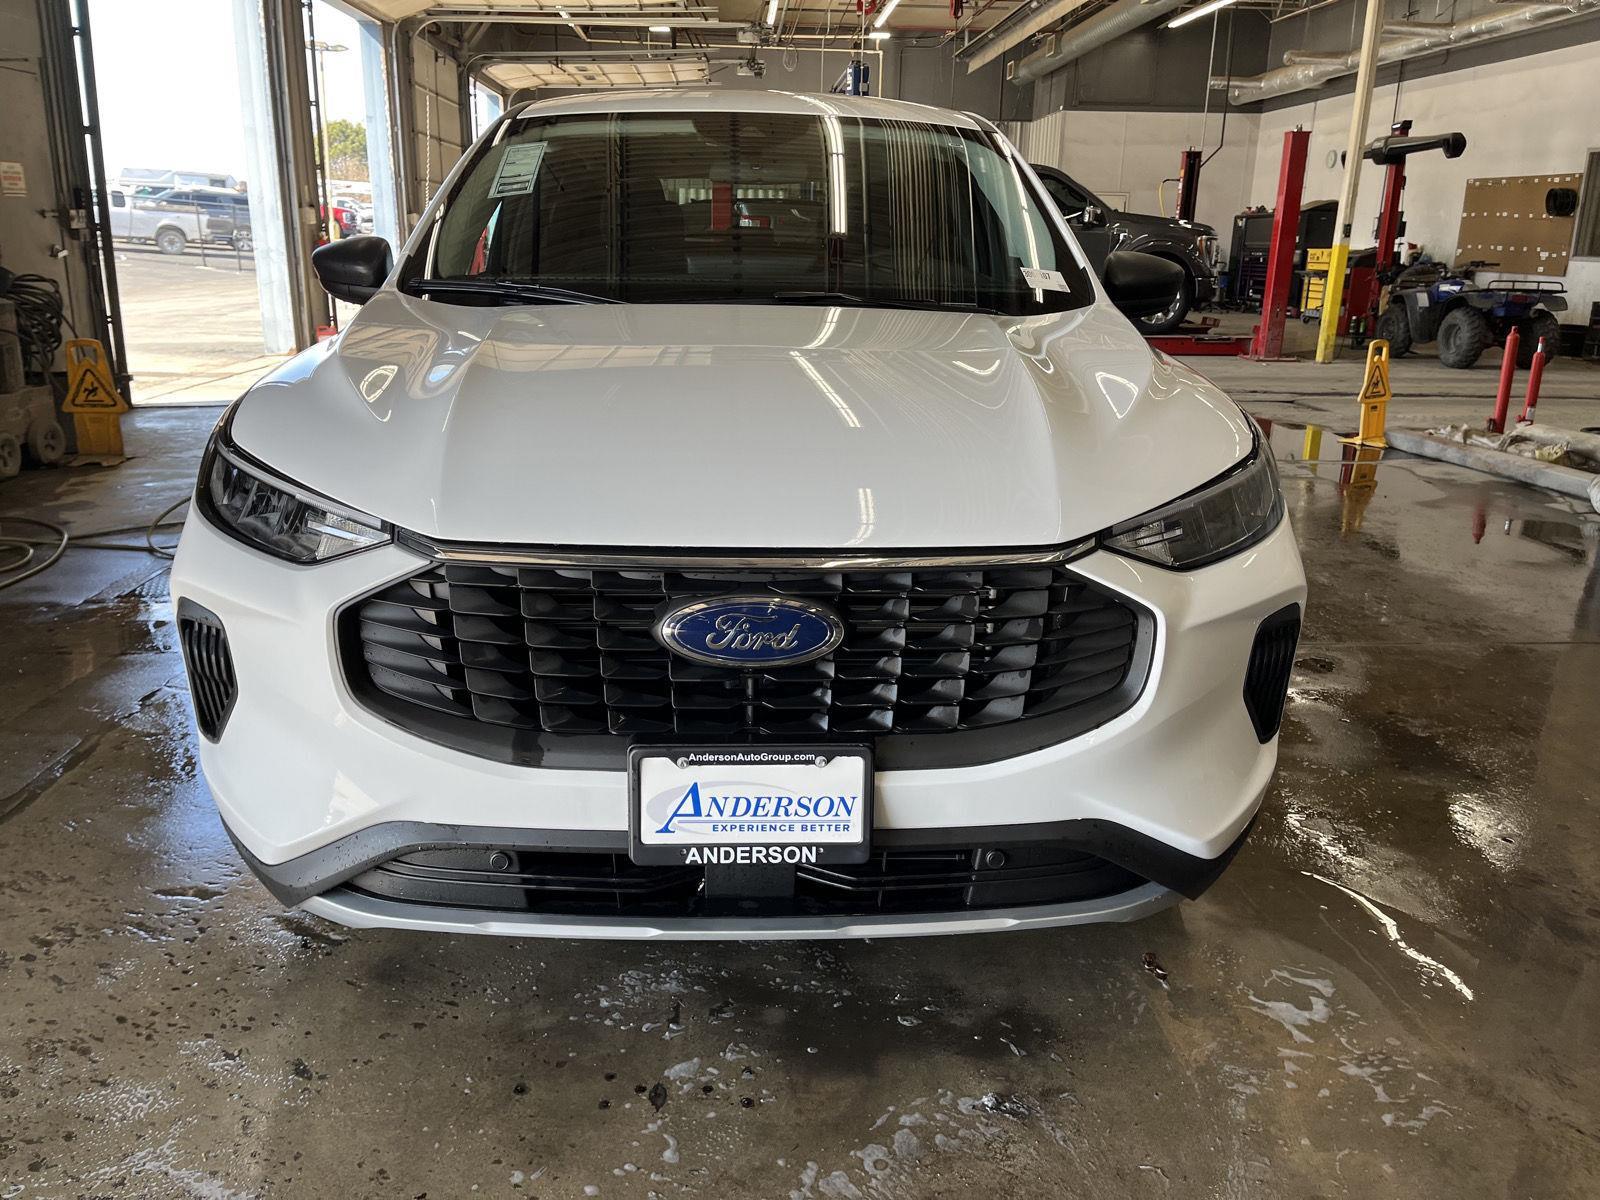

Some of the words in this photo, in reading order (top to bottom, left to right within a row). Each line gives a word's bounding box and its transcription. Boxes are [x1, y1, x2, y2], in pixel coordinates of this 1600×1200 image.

[705, 613, 801, 651] Ford
[688, 753, 816, 763] AndersonAutoGroup.com
[655, 781, 858, 834] ANDERSON
[712, 824, 795, 832] EXPERIENCE
[801, 824, 850, 832] BETTER
[685, 846, 817, 864] ANDERSON
